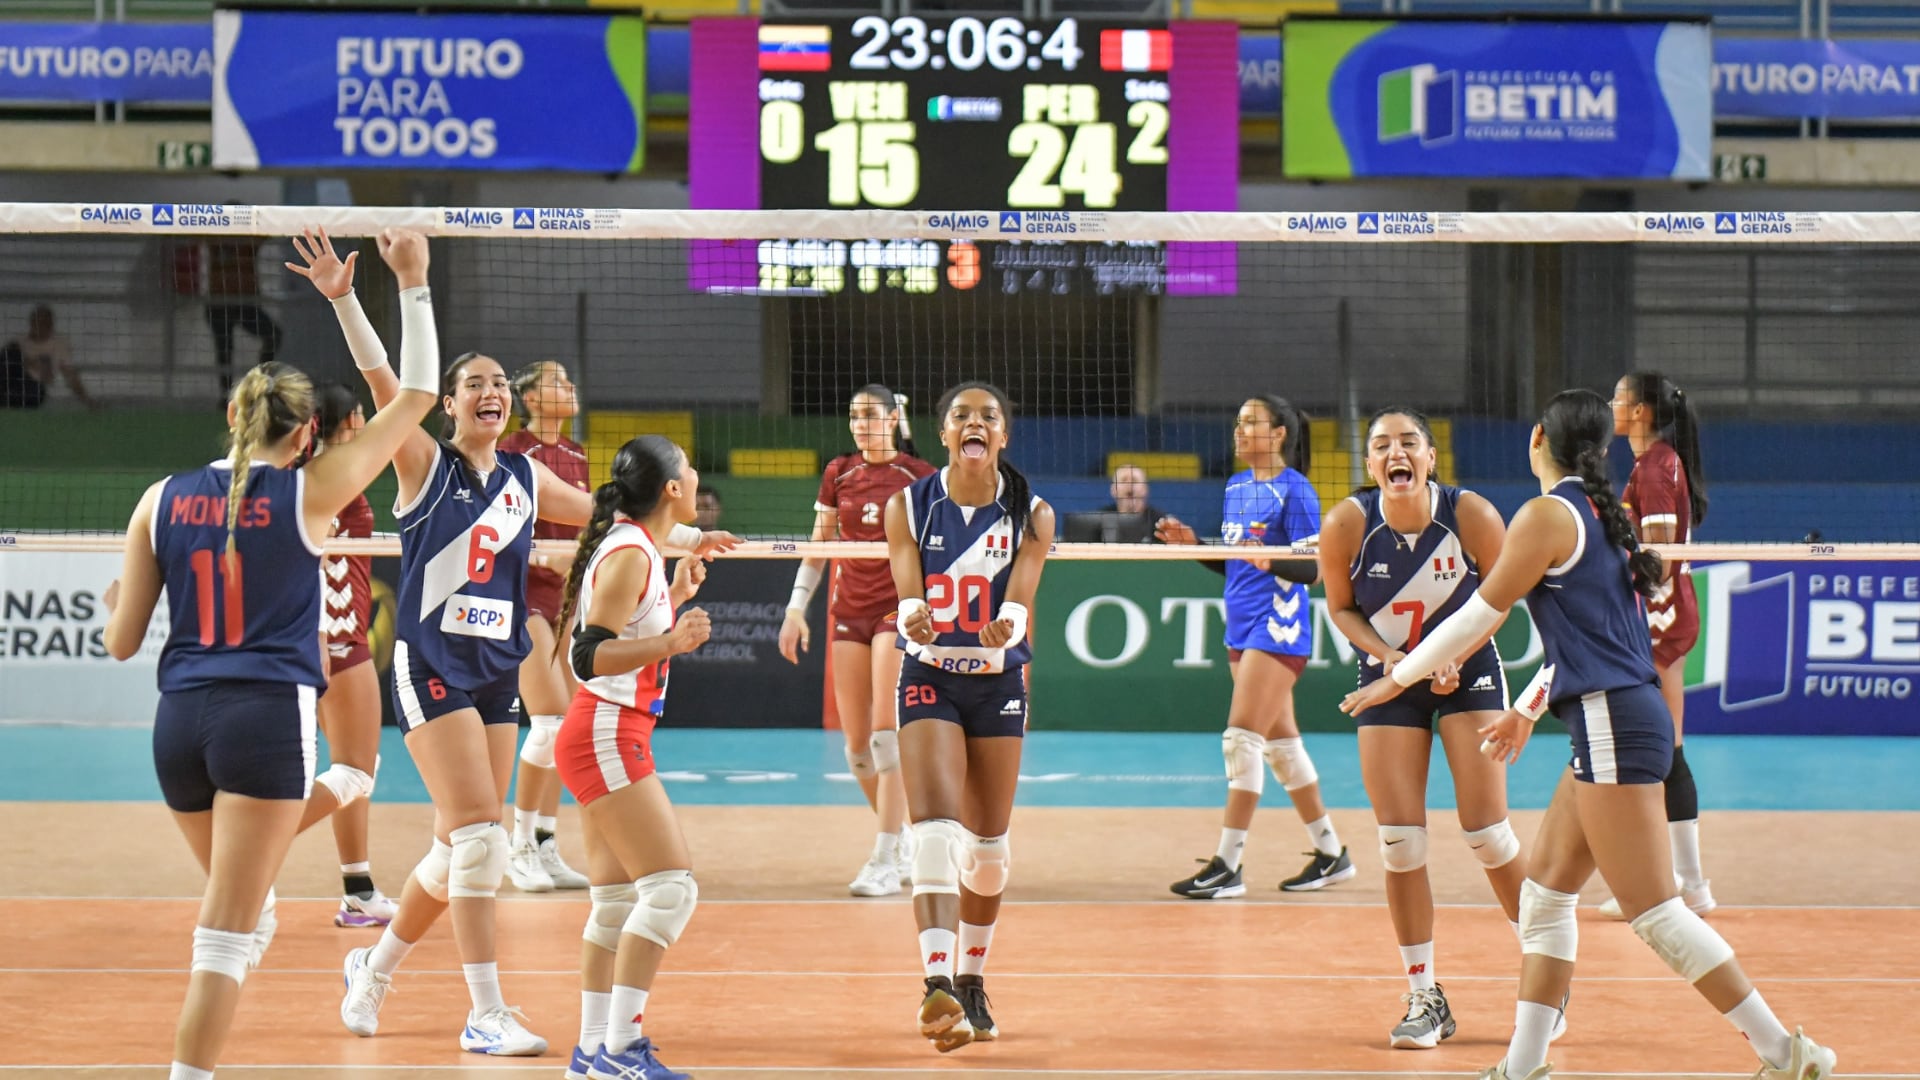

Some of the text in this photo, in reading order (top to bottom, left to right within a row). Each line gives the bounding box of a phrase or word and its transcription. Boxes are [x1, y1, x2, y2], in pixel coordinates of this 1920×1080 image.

[850, 16, 1084, 71] 23:06:4
[134, 47, 213, 77] PARA
[337, 37, 524, 79] FUTURO
[1465, 70, 1582, 83] PREFEITURA
[1821, 64, 1902, 94] PARA
[338, 77, 453, 117] PARA
[1023, 84, 1099, 122] PER
[1465, 84, 1617, 121] BETIM
[334, 117, 498, 159] TODOS
[760, 100, 804, 163] 0
[1127, 101, 1169, 164] 2
[1464, 126, 1617, 141] FUTURO PARA TODOS
[814, 121, 919, 207] 15
[1008, 122, 1119, 208] 24
[81, 205, 142, 223] GASMIG
[178, 205, 223, 214] MINAS
[539, 208, 584, 218] MINAS
[1026, 212, 1070, 221] MINAS
[1384, 213, 1428, 222] MINAS
[1741, 212, 1786, 222] MINAS
[179, 216, 230, 226] GERAIS
[539, 220, 591, 230] GERAIS
[928, 213, 989, 231] GASMIG
[1026, 223, 1077, 233] GERAIS
[1288, 214, 1347, 233] GASMIG
[1384, 224, 1434, 234] GERAIS
[1644, 214, 1705, 232] GASMIG
[1741, 223, 1792, 233] GERAIS
[947, 243, 981, 289] 3
[170, 495, 271, 528] MONES
[861, 502, 879, 524] 2
[467, 525, 499, 584] 6
[985, 550, 1008, 558] PER
[1434, 571, 1457, 581] PER
[190, 548, 244, 647] 11
[925, 573, 991, 633] 20
[467, 608, 498, 626] BCP
[1392, 600, 1425, 654] 7
[942, 658, 981, 672] BCP
[428, 678, 447, 700] 6
[905, 685, 937, 707] 20
[1804, 676, 1912, 699] FUTURO
